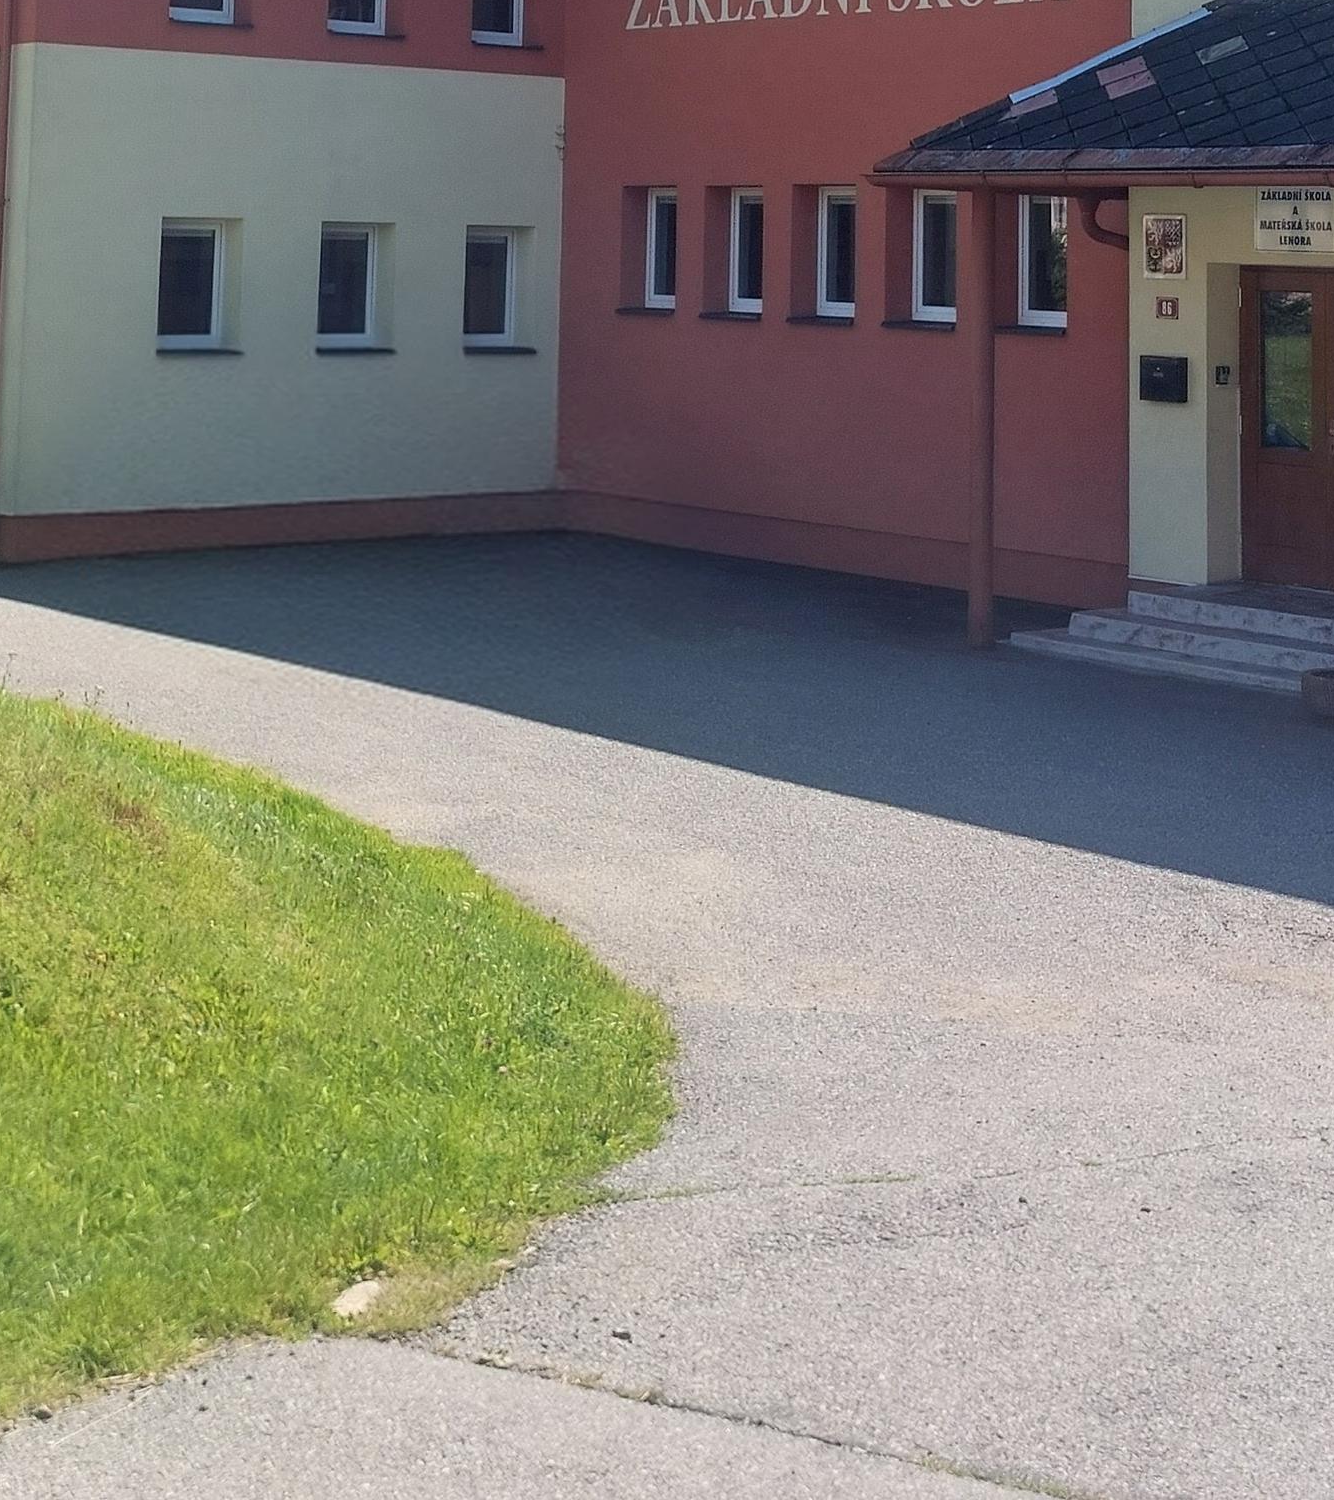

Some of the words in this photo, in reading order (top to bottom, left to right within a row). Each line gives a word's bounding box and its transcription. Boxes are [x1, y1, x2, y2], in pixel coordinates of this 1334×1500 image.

[1261, 188, 1302, 201] ZÁKLADNÍ
[1304, 189, 1331, 201] ŠKOLA
[1292, 205, 1299, 215] A
[1260, 218, 1303, 231] MATEŘSKÁ
[1305, 218, 1332, 231] ŠKOLA
[1279, 235, 1312, 246] LENORA
[1162, 301, 1172, 315] 86
